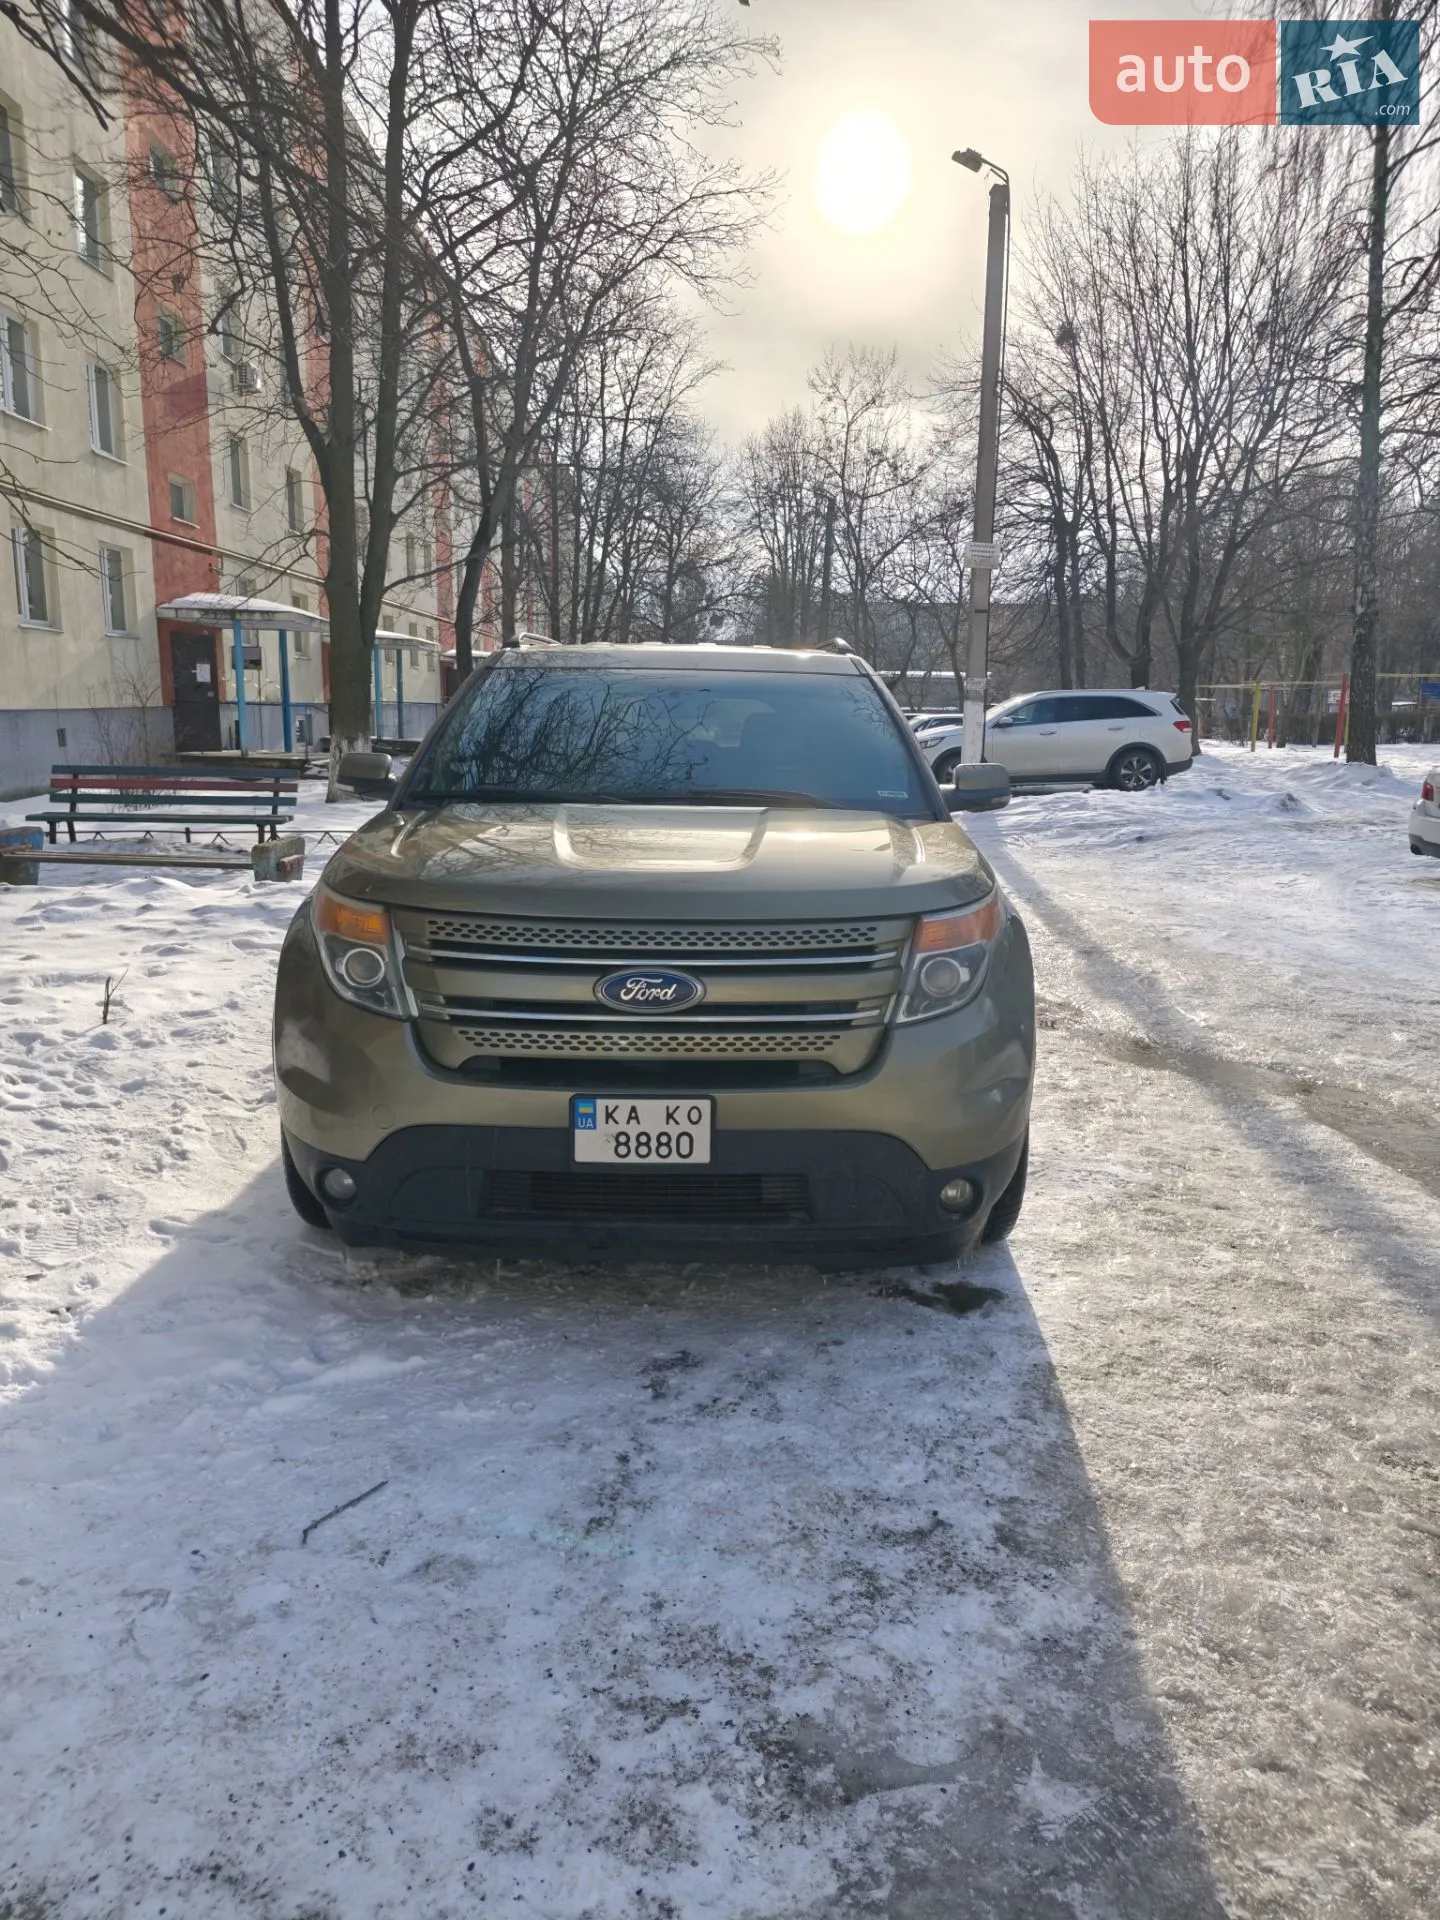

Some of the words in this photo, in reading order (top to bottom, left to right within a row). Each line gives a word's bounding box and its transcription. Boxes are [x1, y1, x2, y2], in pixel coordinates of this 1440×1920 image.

[620, 977, 677, 1000] Ford
[577, 1118, 594, 1128] UA
[604, 1105, 641, 1125] KA
[665, 1105, 702, 1125] KO
[614, 1131, 694, 1159] 8880
